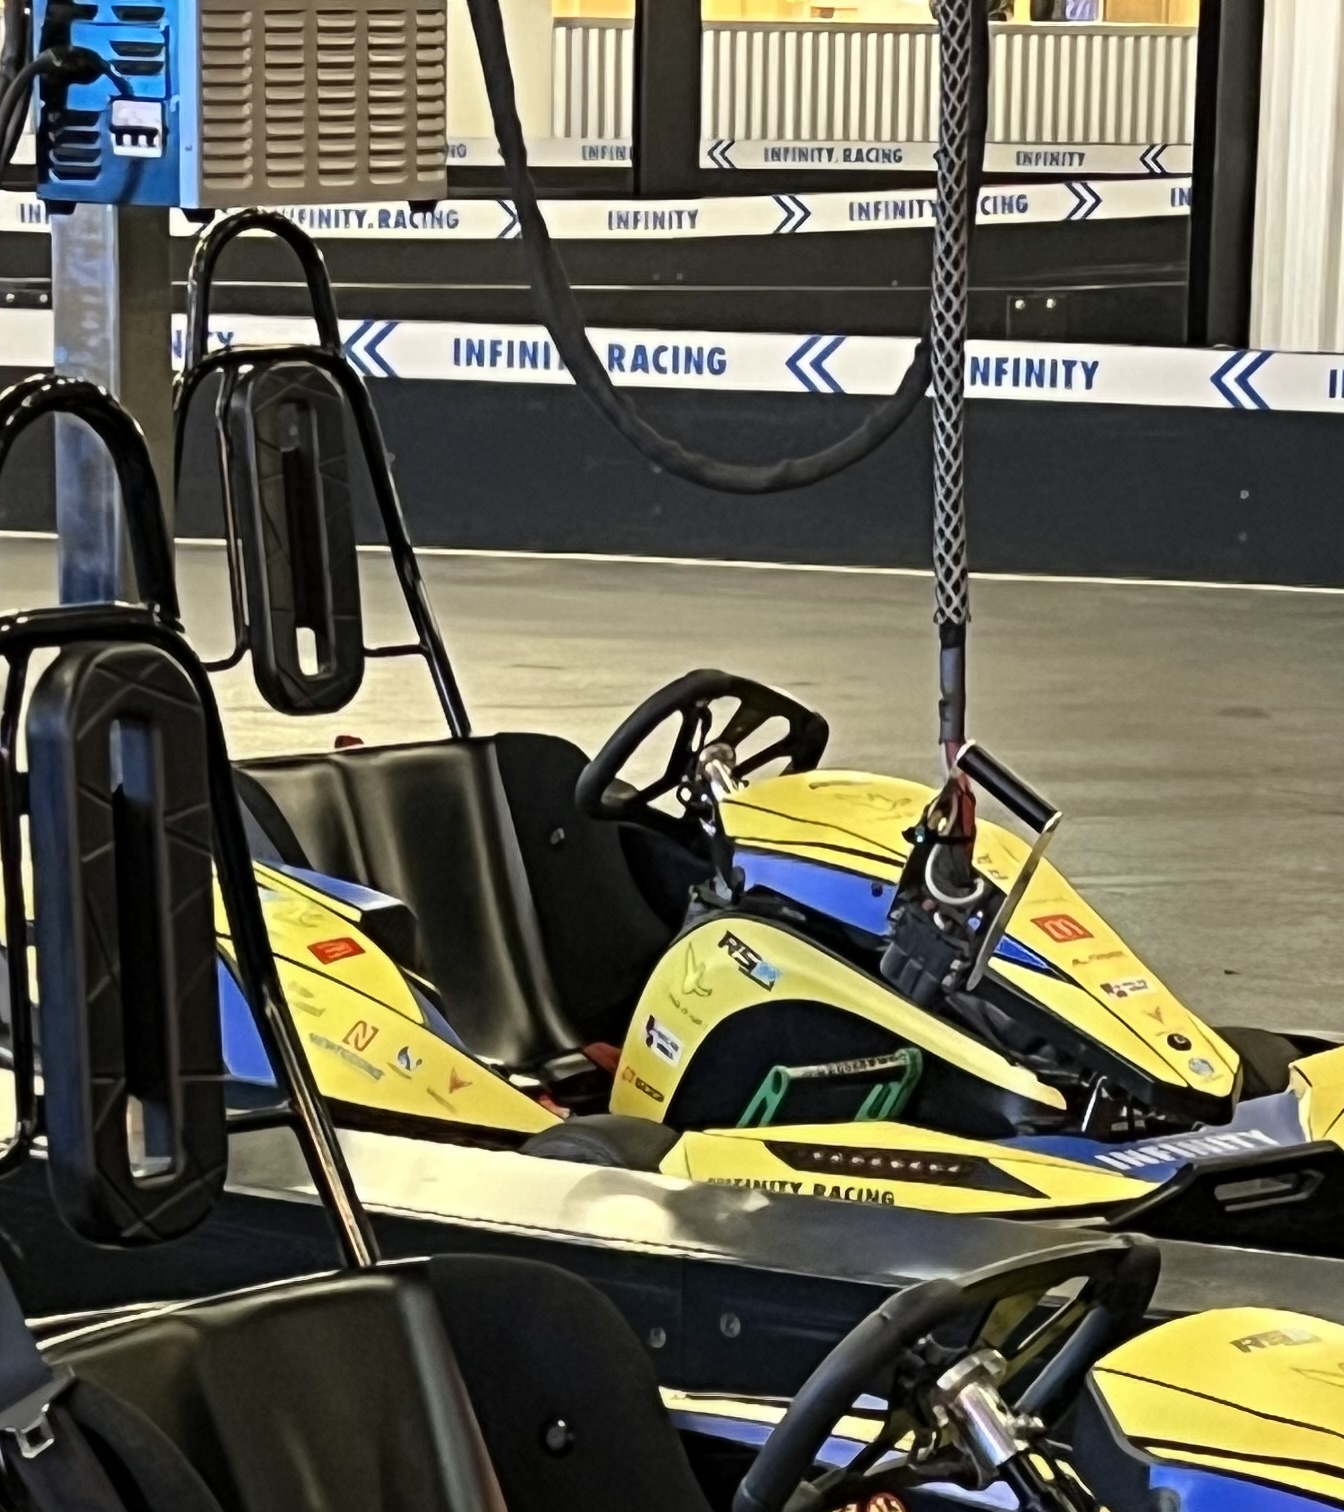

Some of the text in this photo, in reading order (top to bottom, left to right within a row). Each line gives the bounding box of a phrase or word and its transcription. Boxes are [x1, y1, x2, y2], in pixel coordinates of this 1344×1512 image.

[764, 147, 903, 164] INFINITY.RACING
[1015, 150, 1085, 167] INFINITY
[608, 209, 699, 231] INFINITY
[968, 355, 1100, 391] NFINITY
[1093, 1128, 1282, 1171] INFINITY
